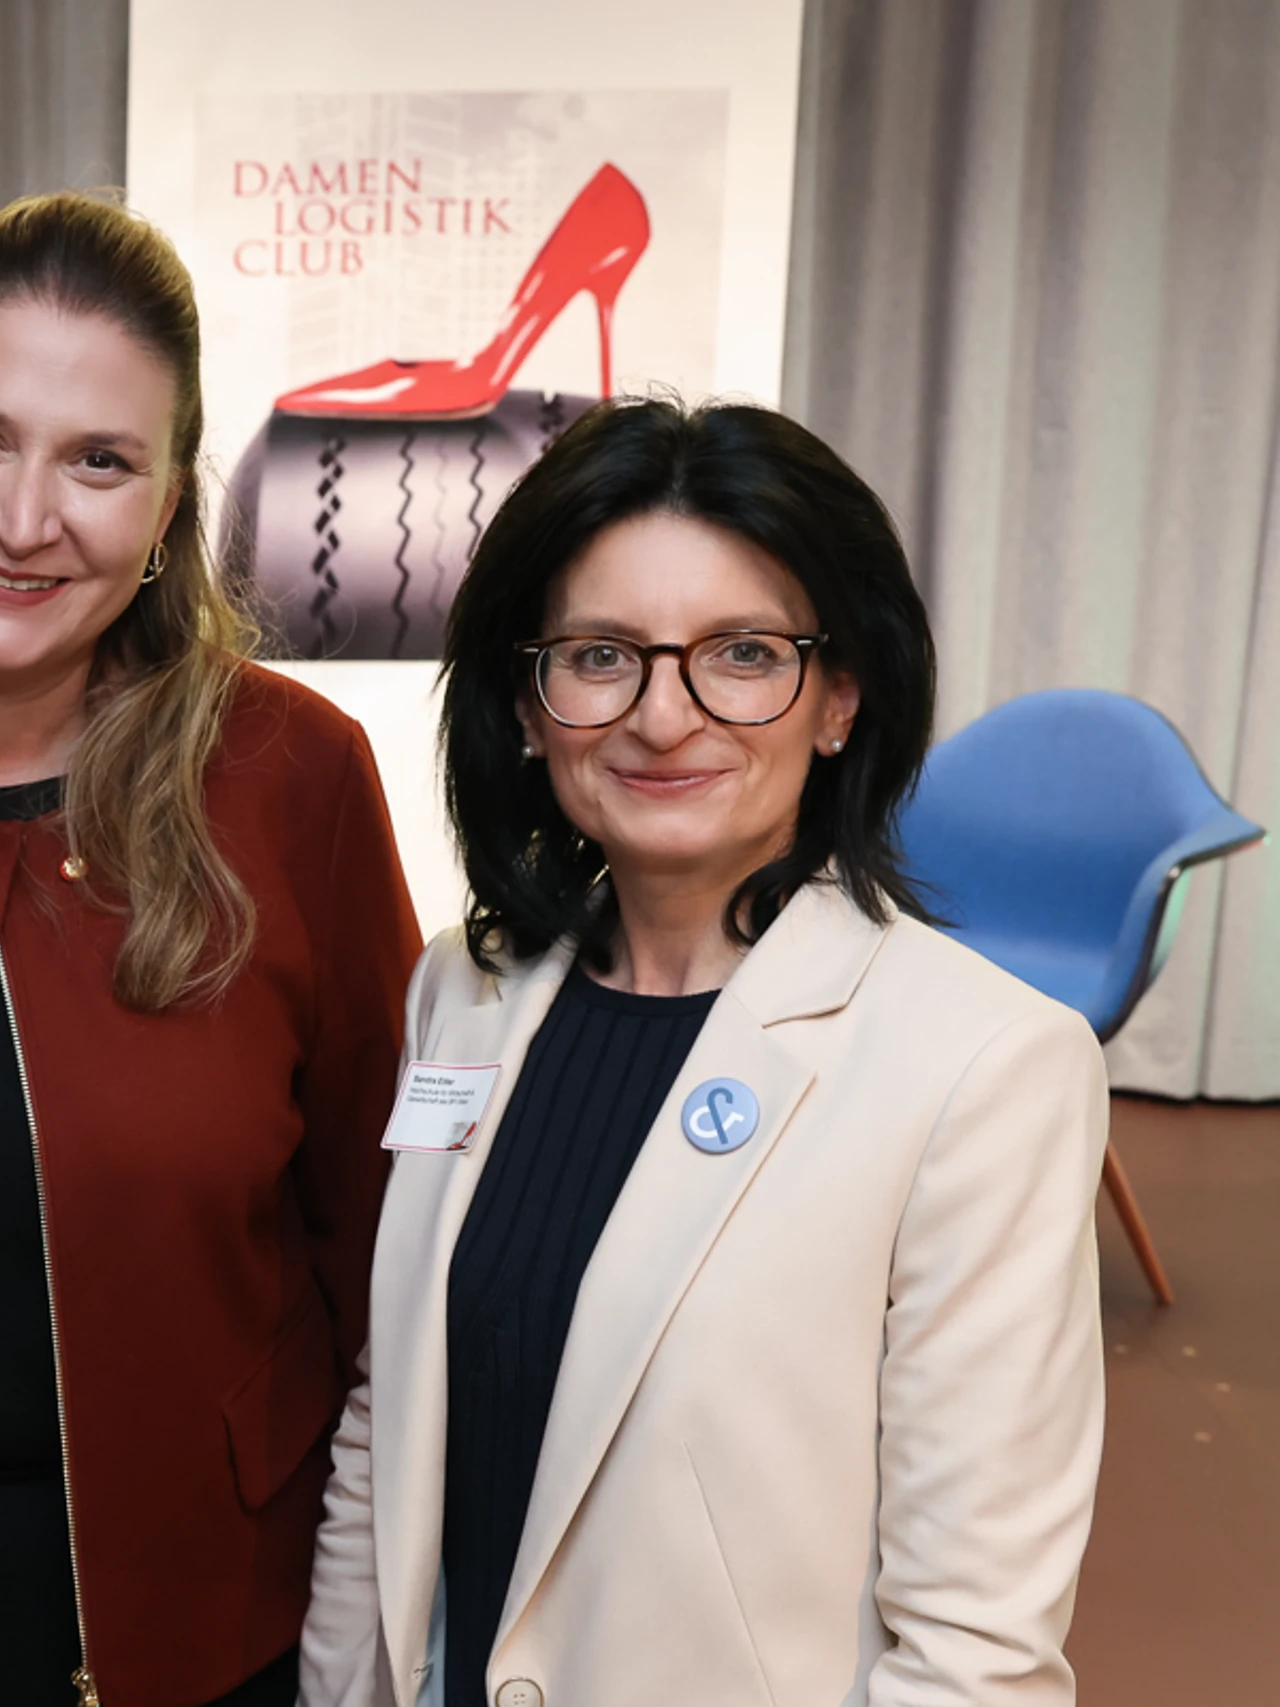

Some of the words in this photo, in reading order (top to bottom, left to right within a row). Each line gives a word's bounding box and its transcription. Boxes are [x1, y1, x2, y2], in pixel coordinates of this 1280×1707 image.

[233, 158, 424, 197] DAMEN
[274, 197, 512, 236] LOGISTIK
[232, 239, 364, 276] CLUB
